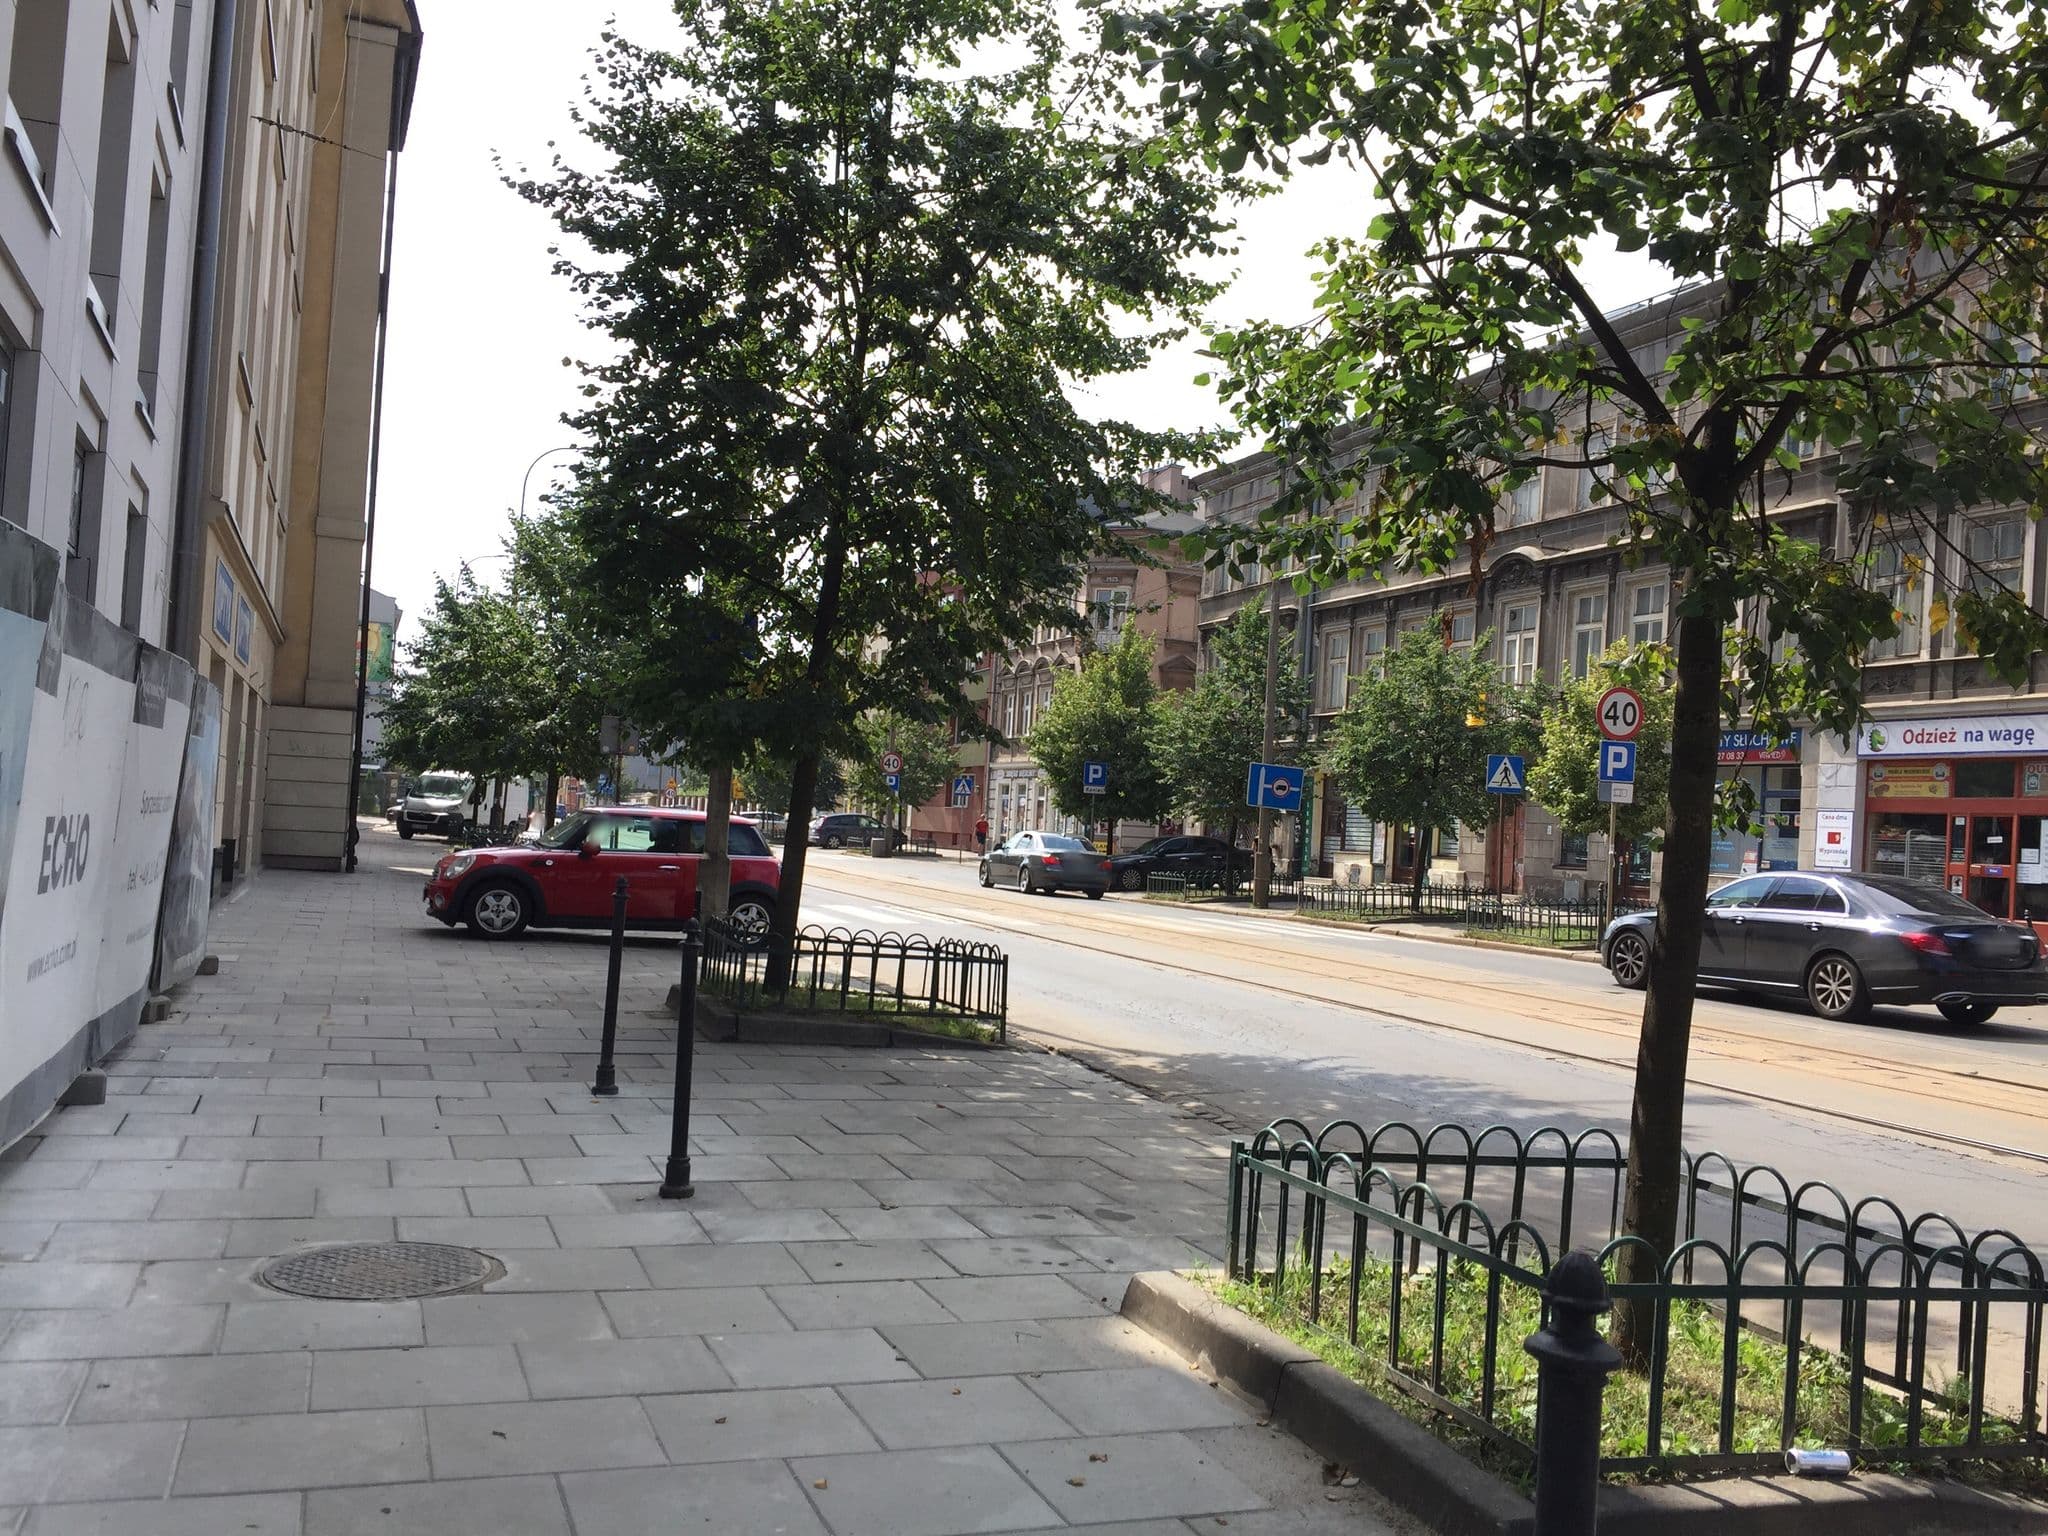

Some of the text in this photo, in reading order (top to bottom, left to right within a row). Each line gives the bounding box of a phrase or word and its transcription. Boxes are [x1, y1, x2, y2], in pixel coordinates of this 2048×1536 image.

[1604, 701, 1637, 727] 40
[1903, 727, 2035, 746] Odzież na wagę
[884, 758, 899, 769] 40
[1607, 745, 1628, 777] P
[1088, 765, 1102, 783] P
[37, 813, 90, 895] ECHO
